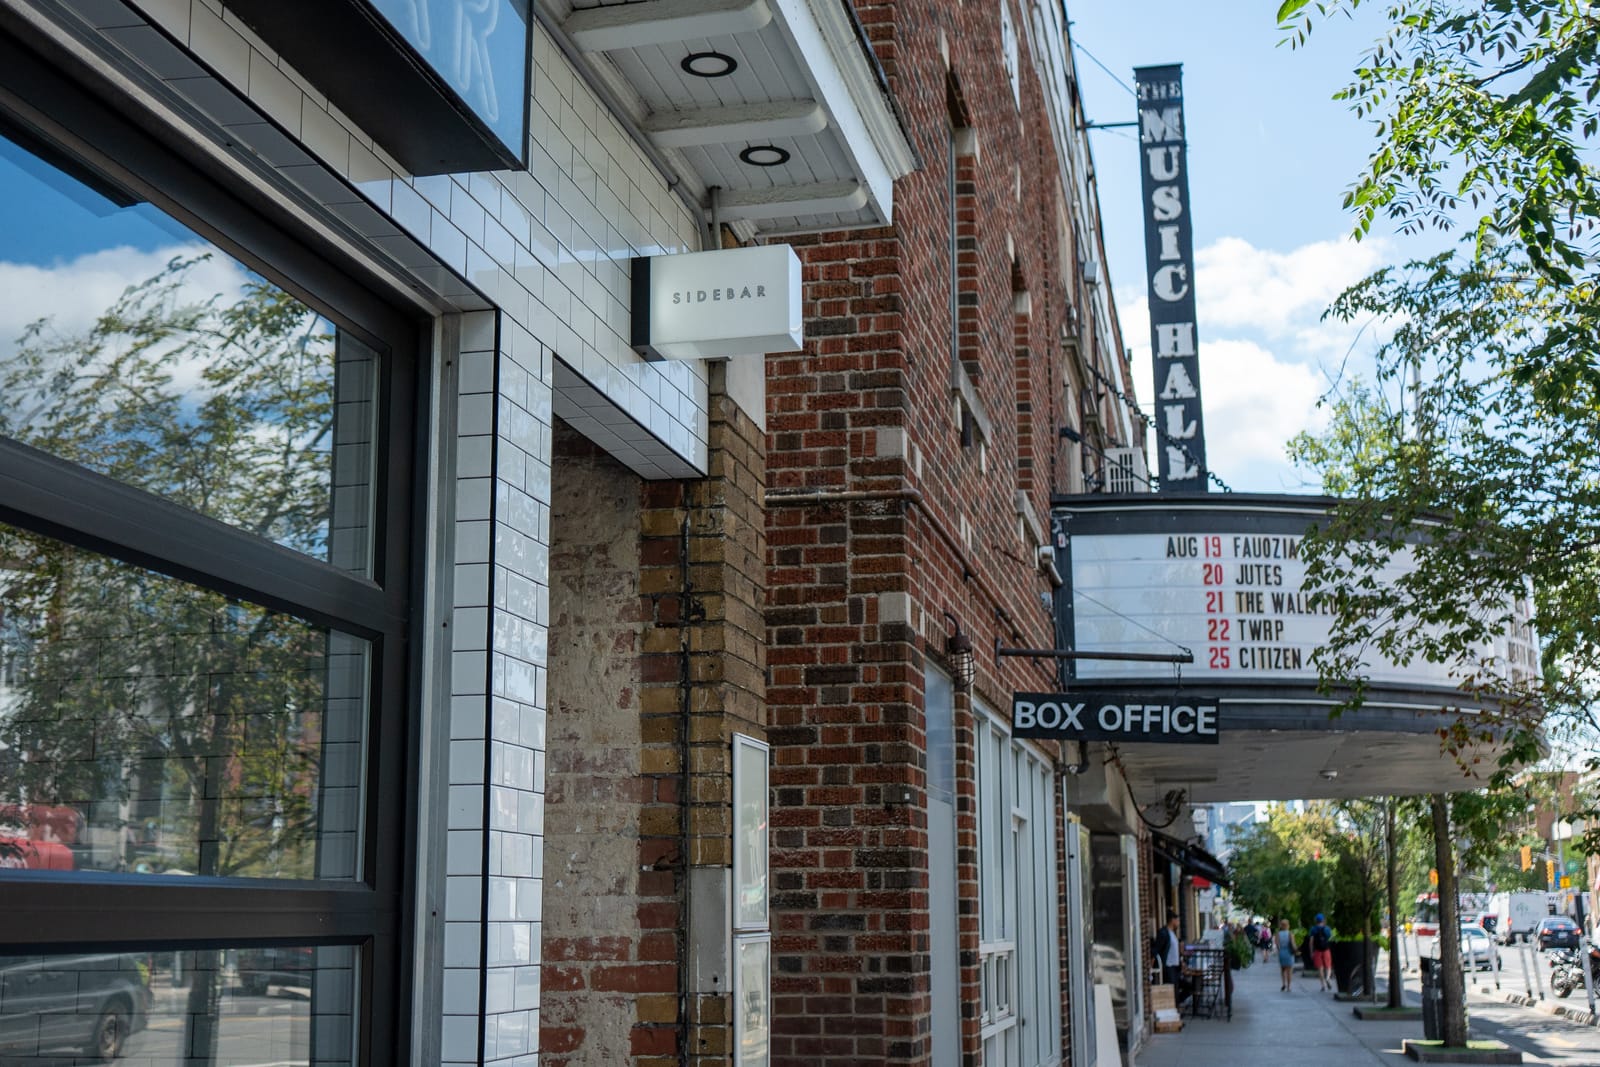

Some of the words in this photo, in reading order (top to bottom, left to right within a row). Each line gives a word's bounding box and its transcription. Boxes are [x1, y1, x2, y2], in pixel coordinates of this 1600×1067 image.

[1140, 81, 1181, 101] THE
[1141, 107, 1189, 302] MUSIC
[672, 285, 766, 304] SIDEBAR
[1155, 322, 1199, 481] HALL
[1166, 536, 1198, 559] AUG
[1204, 536, 1222, 558] 19
[1203, 563, 1224, 586] 20
[1235, 564, 1282, 586] JUTES
[1206, 591, 1224, 614] 21
[1235, 591, 1264, 614] THE
[1208, 619, 1231, 642] 22
[1237, 619, 1284, 642] TWRP
[1209, 647, 1231, 670] 25
[1239, 647, 1302, 671] CITIZEN
[1014, 701, 1086, 731] BOX
[1098, 704, 1217, 735] OFFICE
